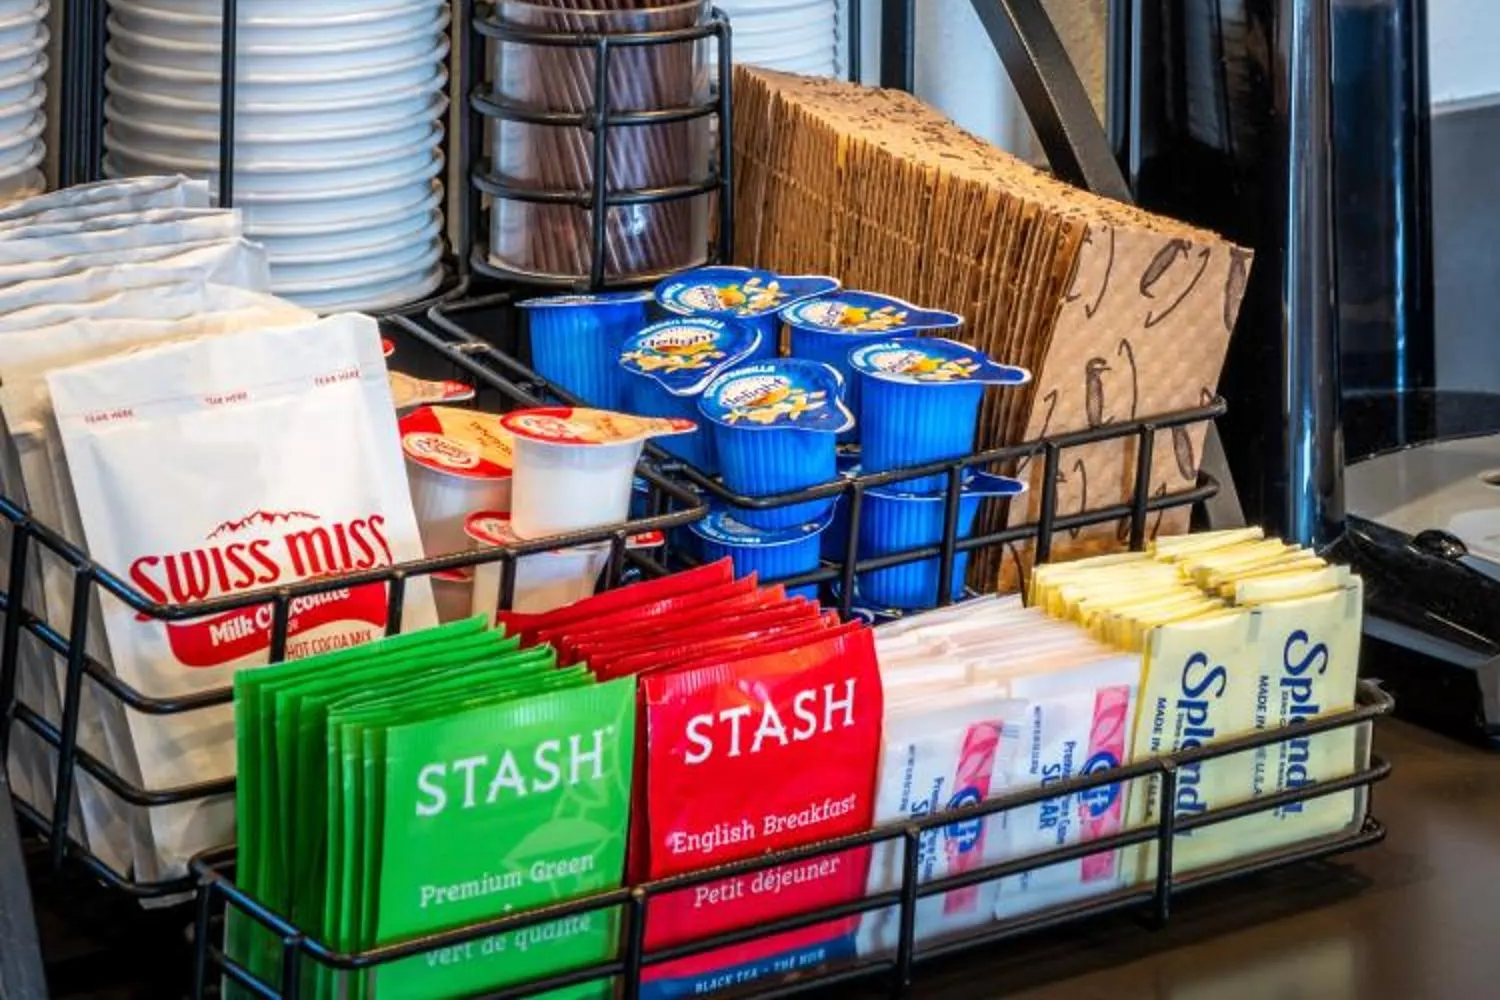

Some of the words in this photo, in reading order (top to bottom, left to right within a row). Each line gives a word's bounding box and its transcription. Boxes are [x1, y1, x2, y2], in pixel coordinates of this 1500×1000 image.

[128, 539, 281, 622] SWISS
[209, 618, 253, 646] Milk
[684, 677, 857, 764] STASH
[1153, 697, 1168, 736] MADE
[1257, 675, 1270, 713] MADE
[415, 728, 605, 816] STASH
[672, 819, 755, 853] English
[763, 793, 857, 836] Breakfast
[420, 871, 522, 908] Premium
[530, 854, 594, 881] Green
[693, 876, 745, 908] Petit
[751, 857, 841, 894] déjeuner
